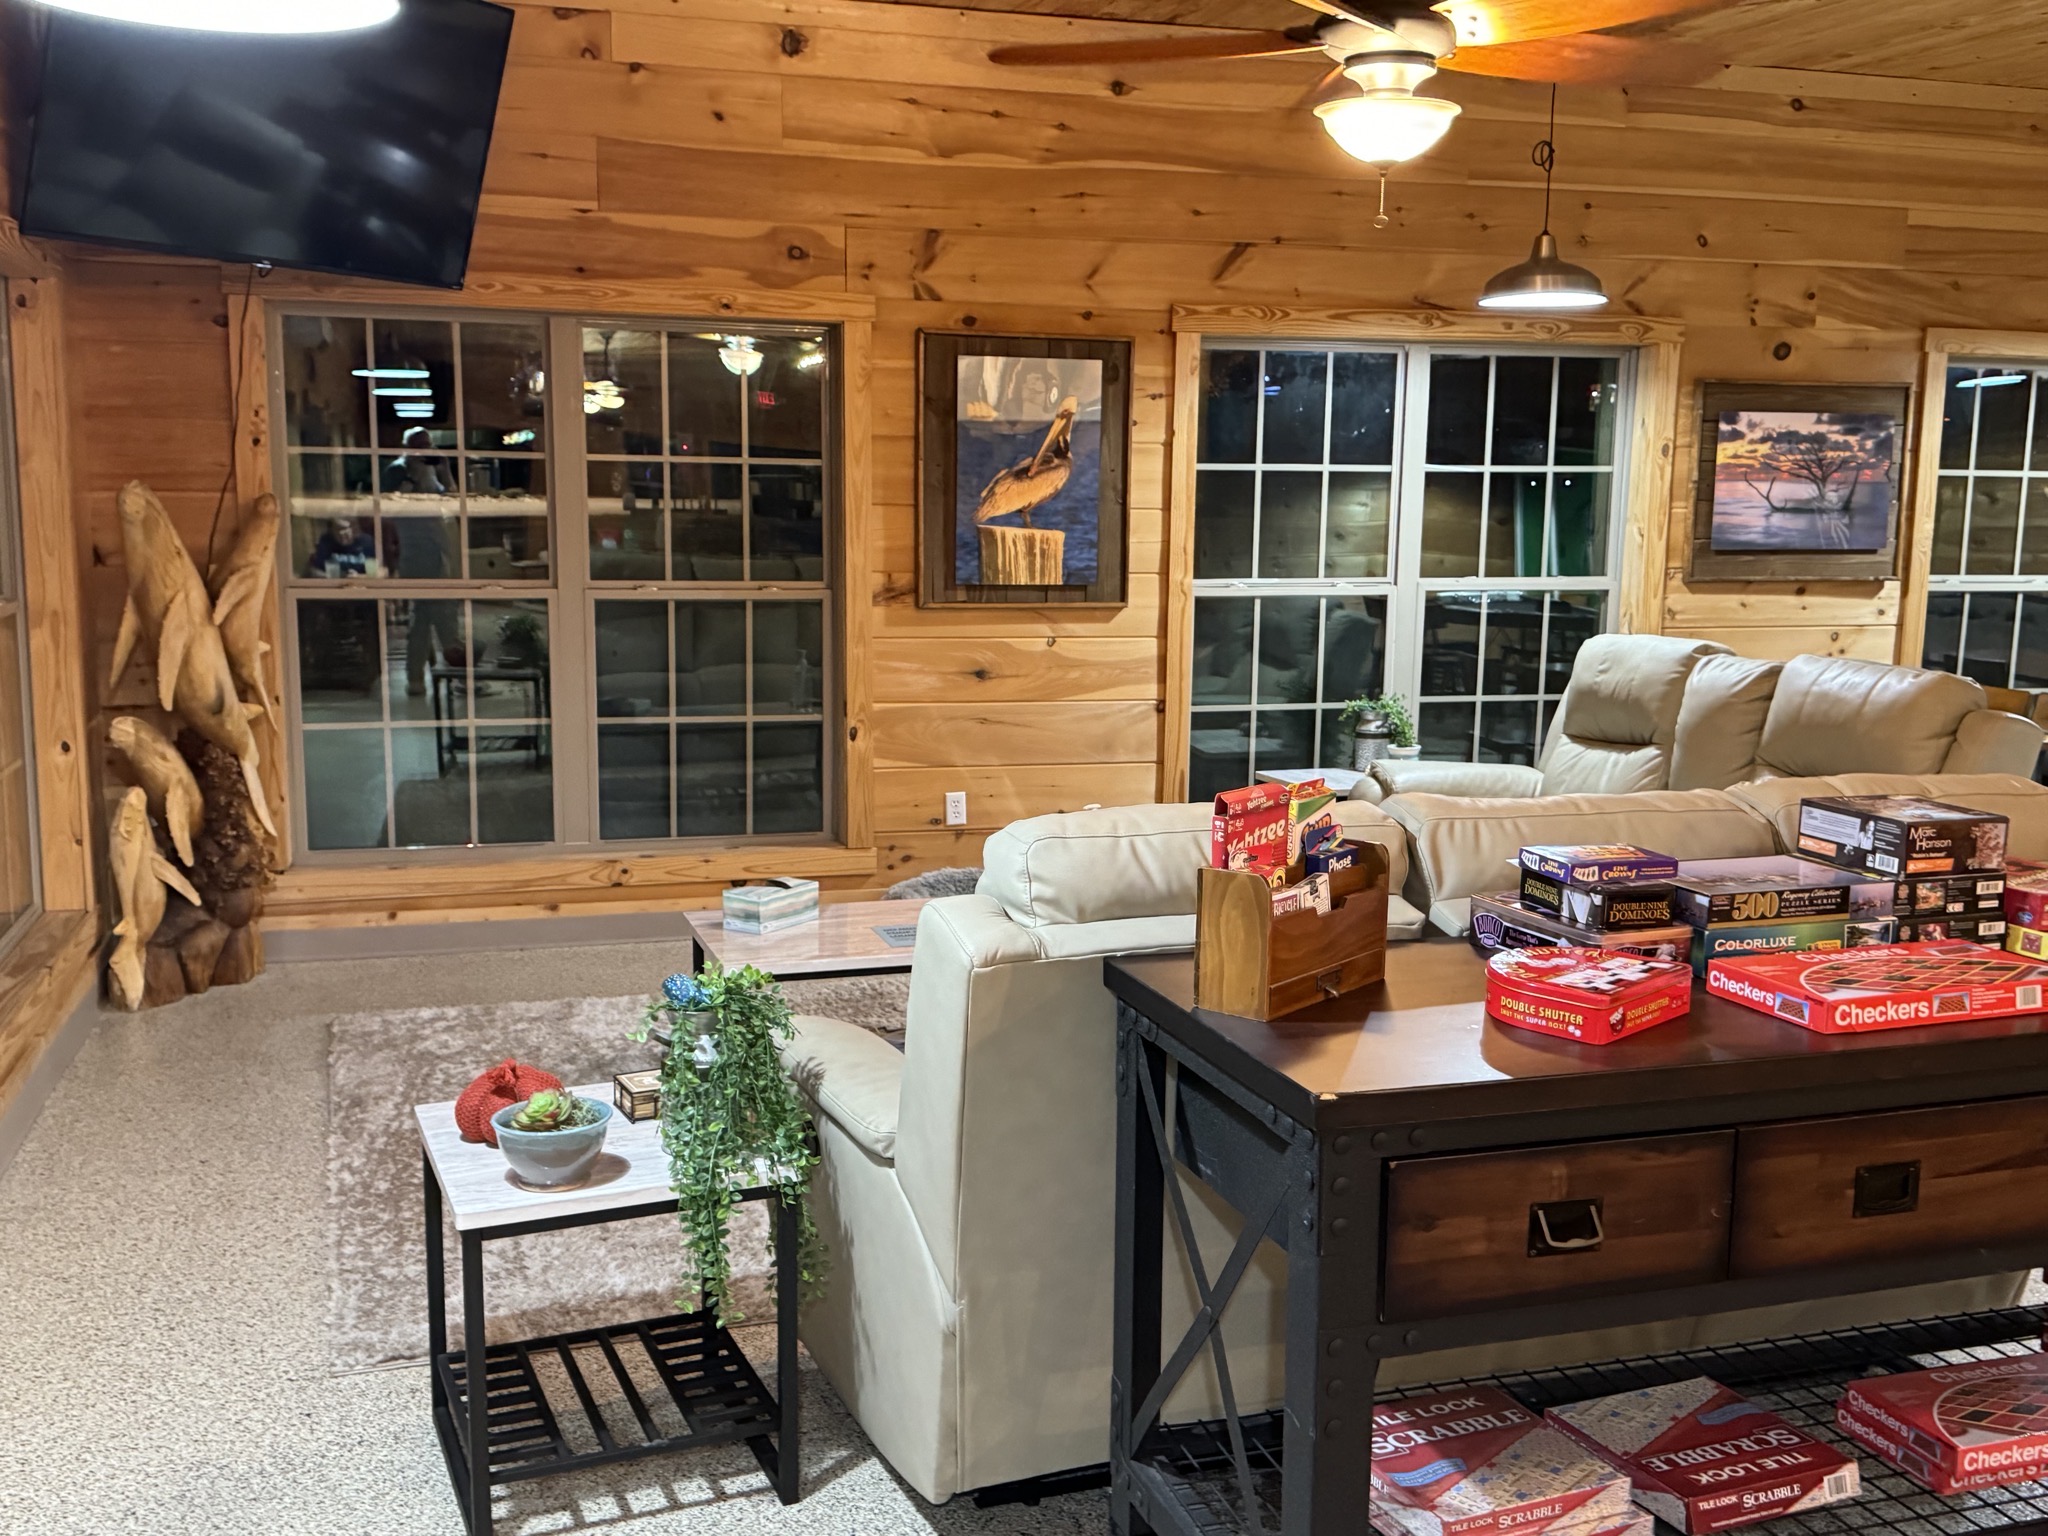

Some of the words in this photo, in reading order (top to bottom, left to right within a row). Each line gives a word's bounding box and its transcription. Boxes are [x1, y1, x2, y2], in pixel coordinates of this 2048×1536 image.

[1909, 826, 1937, 840] Marc
[1916, 838, 1952, 851] Hanson
[1524, 884, 1559, 906] DOMINOES
[1613, 901, 1668, 911] DOUBLE-NINE
[1732, 891, 1780, 920] 500
[1477, 915, 1501, 937] BUNCO
[1609, 908, 1671, 922] DOMINOES
[1714, 936, 1798, 952] COLORLUXE
[1795, 948, 1909, 963] Checkers
[1709, 970, 1774, 1006] Checkers
[1500, 996, 1536, 1015] DOUBLE
[1538, 1006, 1584, 1026] SHUTTER
[1525, 1016, 1547, 1026] SUPER
[1834, 1000, 1930, 1026] Checkers
[1929, 1361, 2038, 1383] Checkers
[1415, 1396, 1486, 1418] LOCK
[1848, 1389, 1909, 1438] Checkers
[1371, 1408, 1531, 1455] SCRABBLE
[1837, 1408, 1897, 1456] Checkers
[1641, 1429, 1801, 1473] SCRABBLE
[1755, 1452, 1813, 1470] TILE
[1964, 1443, 2048, 1471] Checkers
[1697, 1461, 1762, 1485] LOCK
[1698, 1500, 1716, 1511] TILE
[1715, 1494, 1739, 1507] LOCK
[1742, 1483, 1802, 1508] SCRABBLE
[1451, 1518, 1469, 1533] TILE
[1469, 1516, 1495, 1529] LOCK
[1498, 1503, 1563, 1529] SCRABBLE
